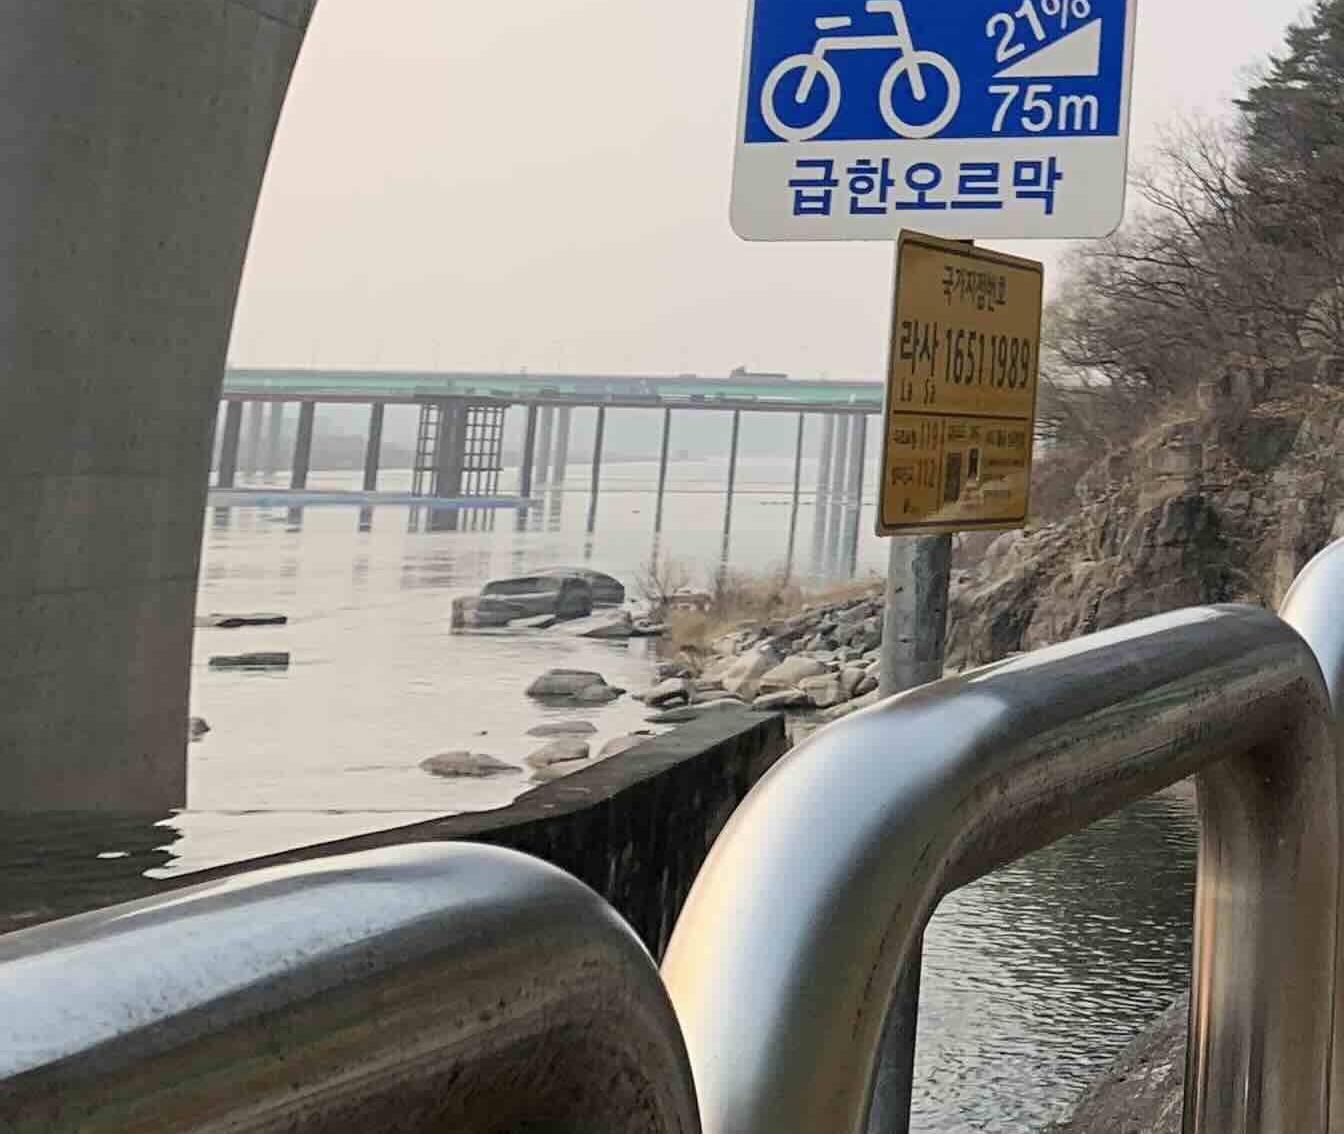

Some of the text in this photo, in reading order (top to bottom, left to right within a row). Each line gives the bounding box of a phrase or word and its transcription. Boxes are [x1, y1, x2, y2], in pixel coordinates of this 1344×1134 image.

[987, 83, 1100, 133] 75m
[787, 155, 1064, 218] 급한오르막
[899, 320, 940, 378] 라사
